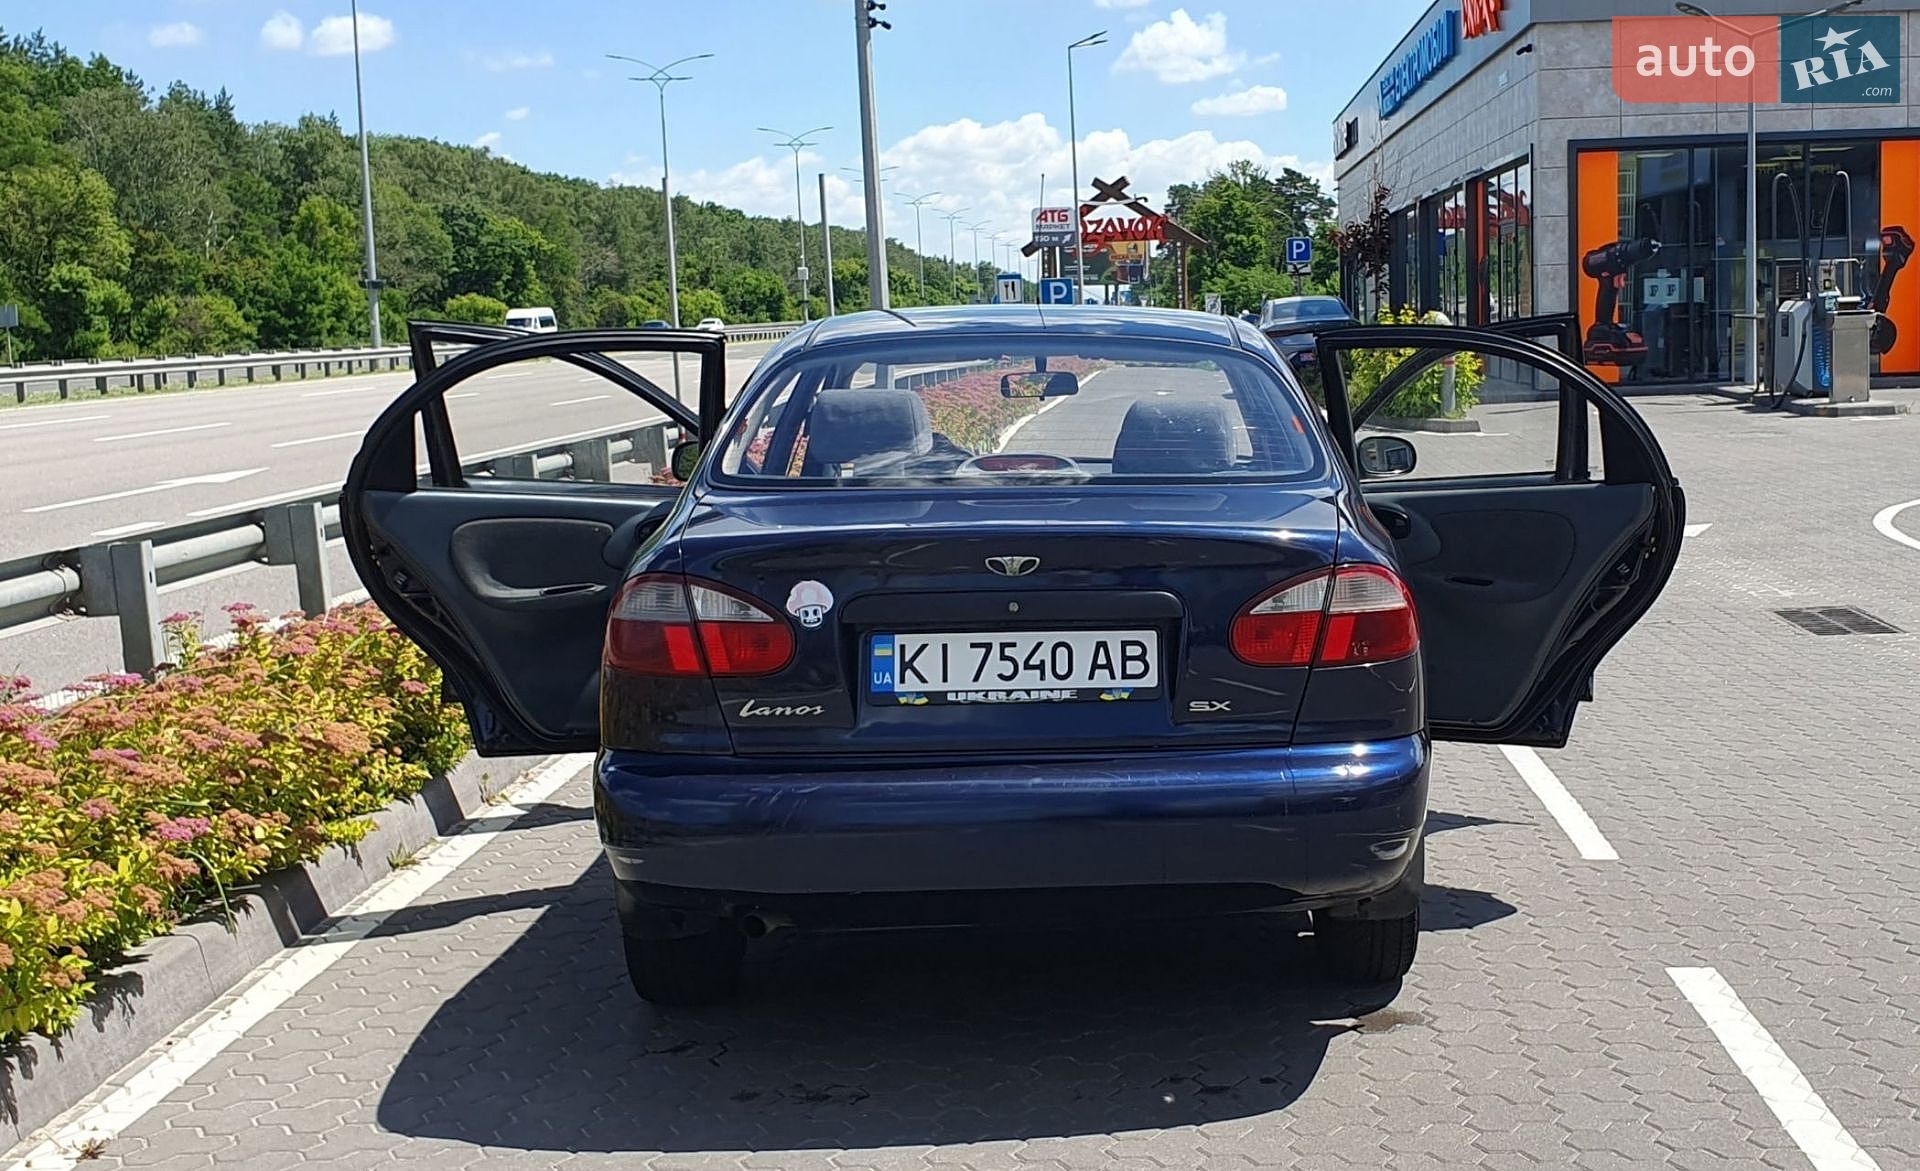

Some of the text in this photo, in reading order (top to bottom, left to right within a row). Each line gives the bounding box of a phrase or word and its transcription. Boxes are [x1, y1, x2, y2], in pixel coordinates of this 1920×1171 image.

[1293, 240, 1306, 259] P
[1049, 281, 1068, 304] P
[873, 640, 1150, 685] UA KI 7540 AB
[946, 689, 1079, 703] UKRAINE
[739, 699, 824, 717] Lanos
[1189, 700, 1231, 711] SX
